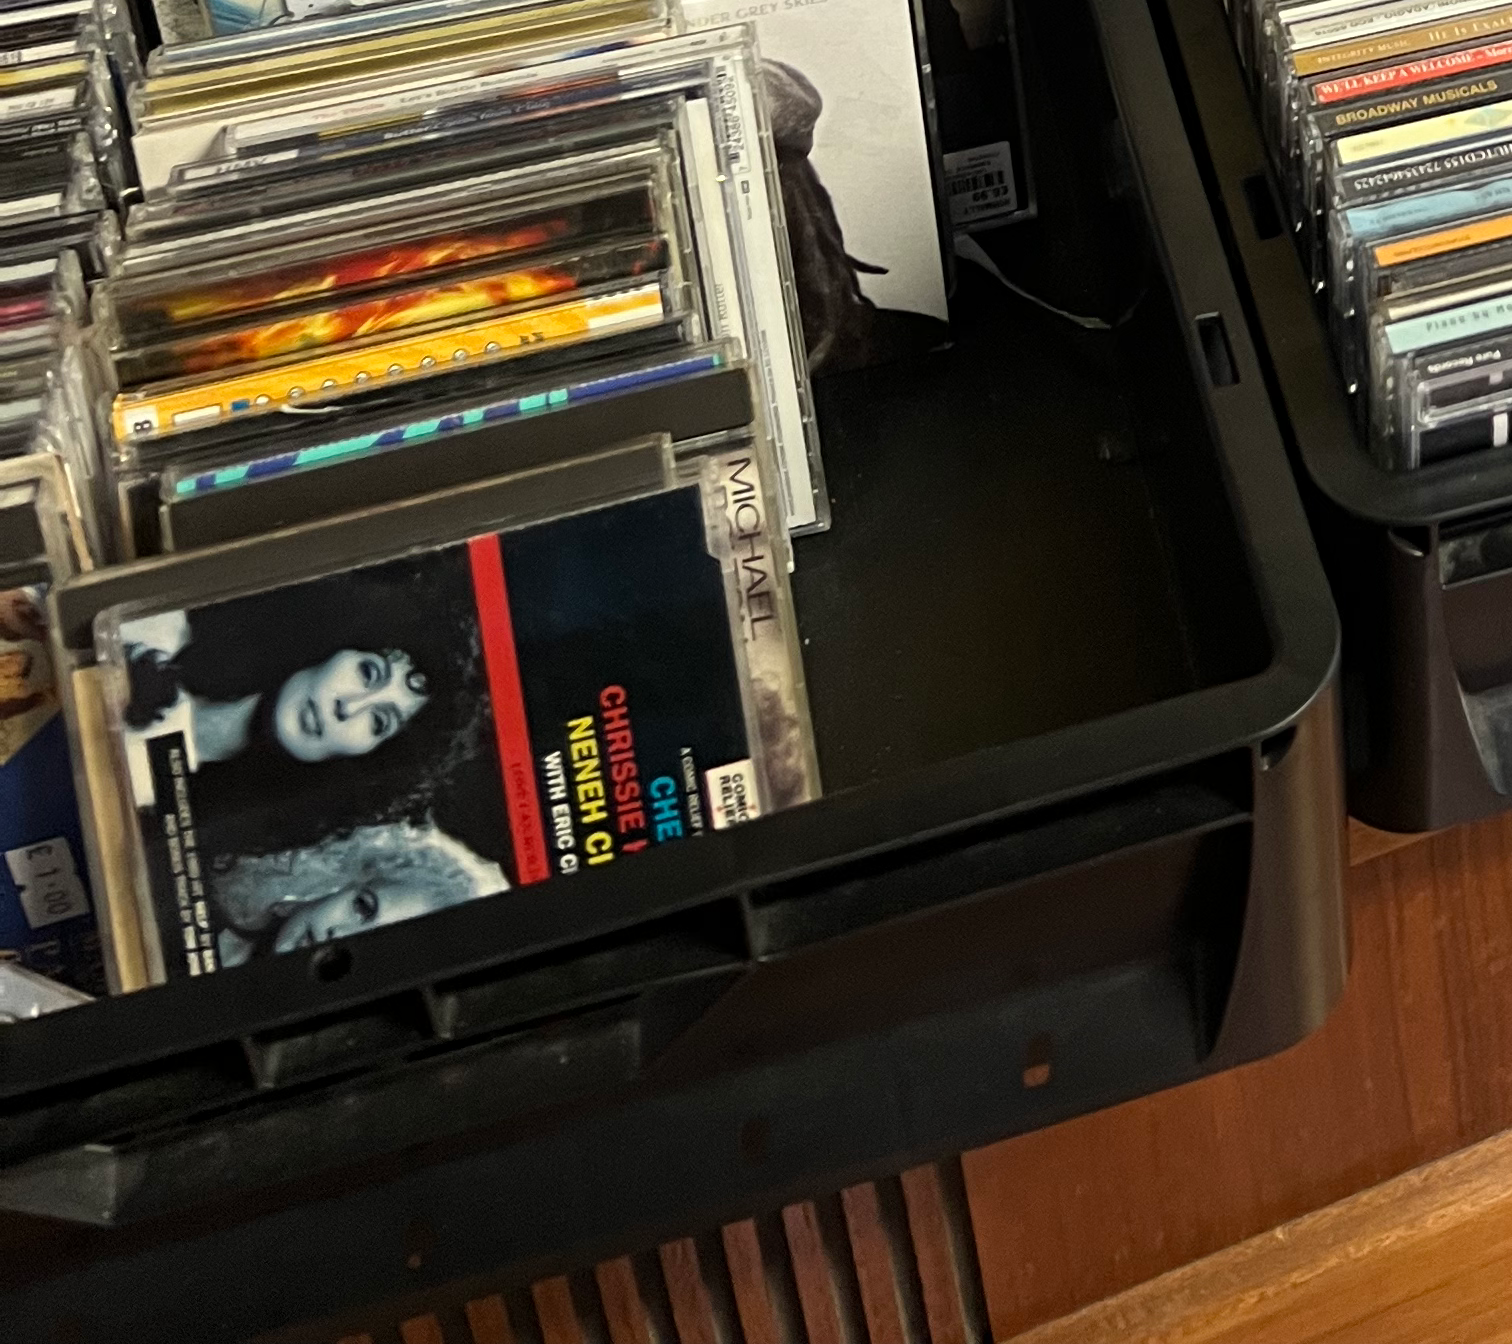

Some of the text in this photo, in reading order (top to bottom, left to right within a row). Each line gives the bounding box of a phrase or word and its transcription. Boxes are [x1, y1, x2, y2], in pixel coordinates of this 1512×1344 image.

[736, 2, 779, 20] GREY
[1335, 99, 1418, 126] BROADWAY
[1423, 79, 1498, 105] MUSICALS
[1427, 355, 1475, 374] Records
[1476, 348, 1502, 364] Pure
[724, 457, 781, 641] MICHAEL
[542, 750, 580, 843] WITH ERIC
[567, 716, 610, 828] NENEH
[598, 683, 645, 850] CHRISSIE
